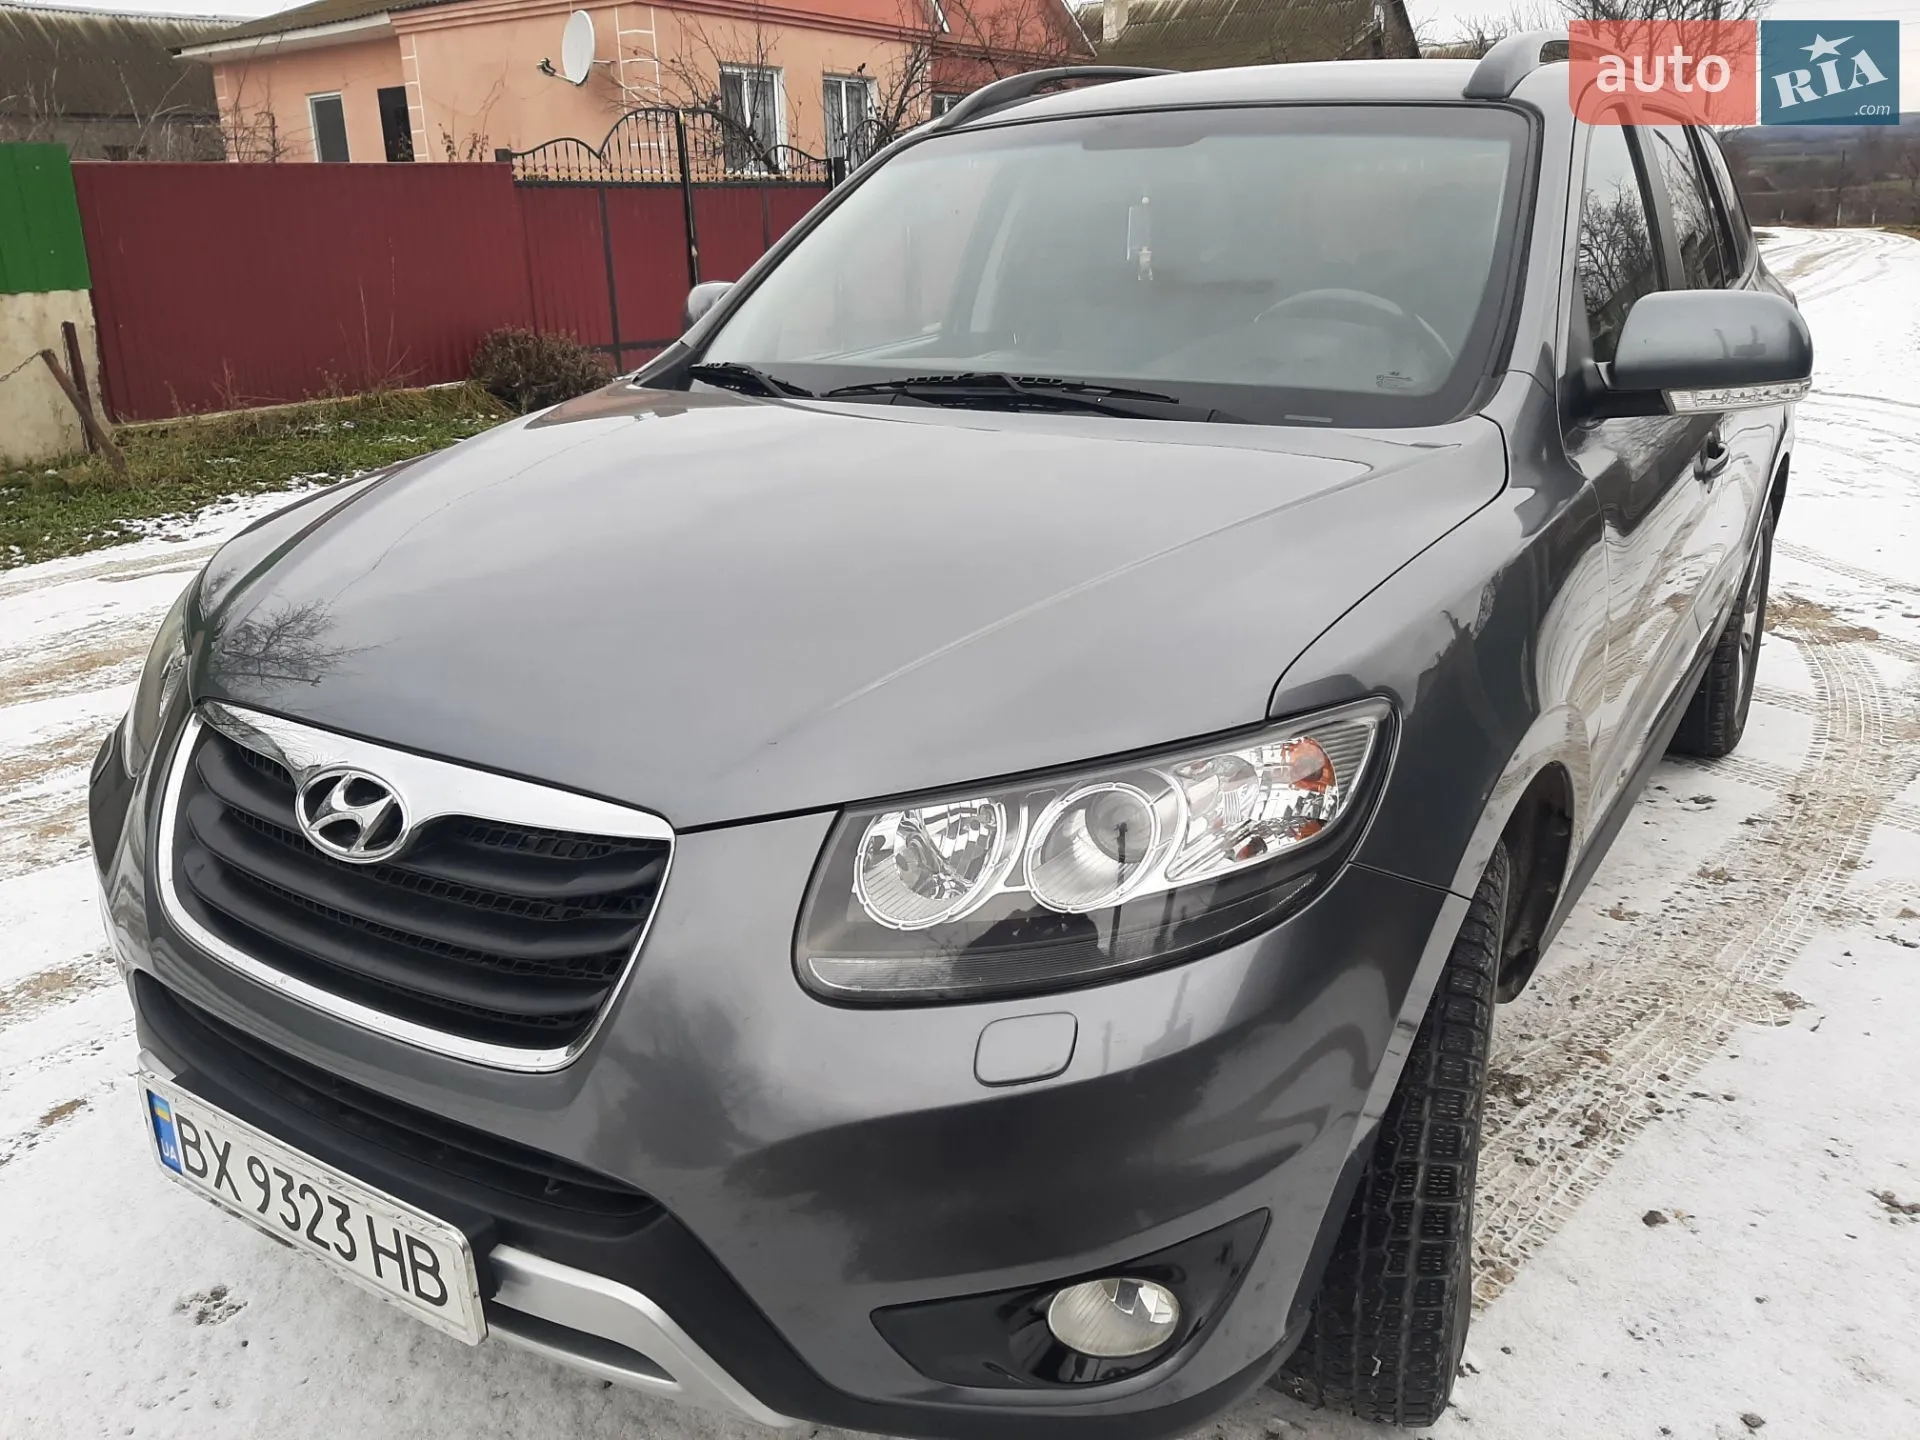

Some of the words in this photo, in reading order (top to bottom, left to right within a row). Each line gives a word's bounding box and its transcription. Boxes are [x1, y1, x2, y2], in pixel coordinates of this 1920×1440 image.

[160, 1138, 179, 1163] UA
[175, 1112, 242, 1202] BX
[246, 1155, 357, 1262] 9323
[366, 1214, 448, 1307] HB
